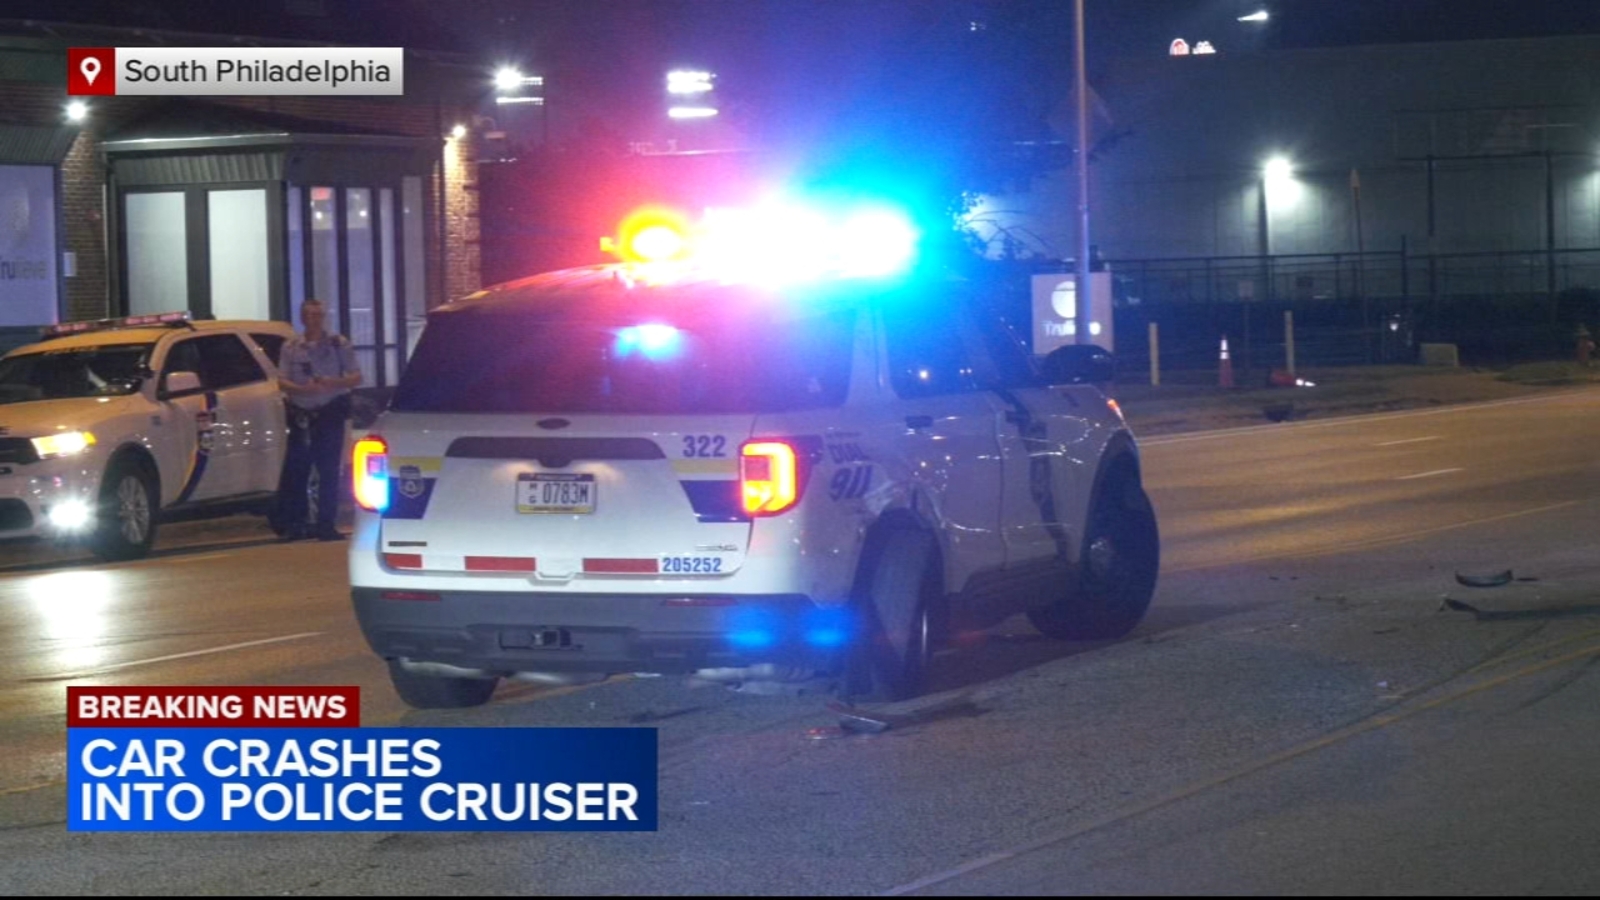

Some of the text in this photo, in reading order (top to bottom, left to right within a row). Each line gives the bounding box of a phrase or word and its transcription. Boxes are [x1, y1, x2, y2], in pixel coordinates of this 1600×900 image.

[682, 434, 726, 458] 322
[829, 465, 873, 502] 911
[662, 557, 723, 573] 205252
